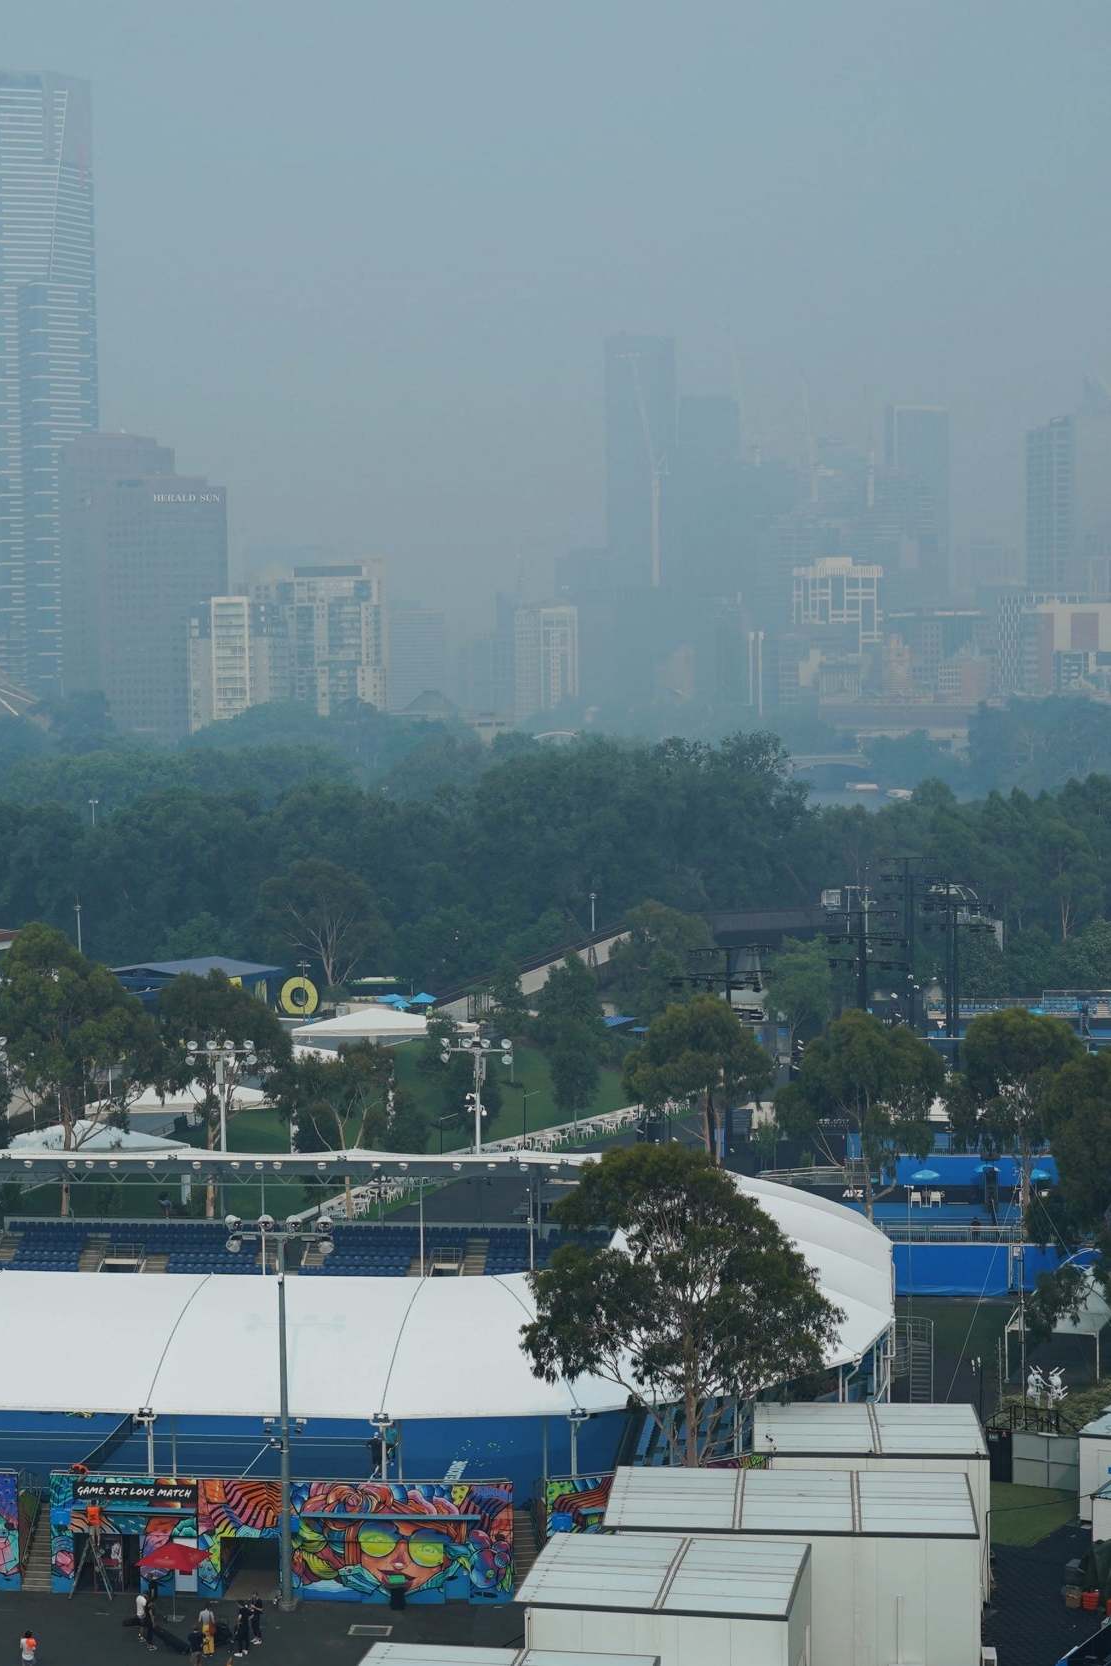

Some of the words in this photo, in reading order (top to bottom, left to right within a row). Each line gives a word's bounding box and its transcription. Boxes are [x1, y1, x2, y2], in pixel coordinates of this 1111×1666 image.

[153, 493, 196, 503] HERALD
[201, 493, 220, 503] SUN
[77, 1486, 106, 1496] GAME.
[109, 1486, 128, 1496] SET.
[130, 1487, 155, 1497] LOVE
[157, 1488, 192, 1498] MATCH
